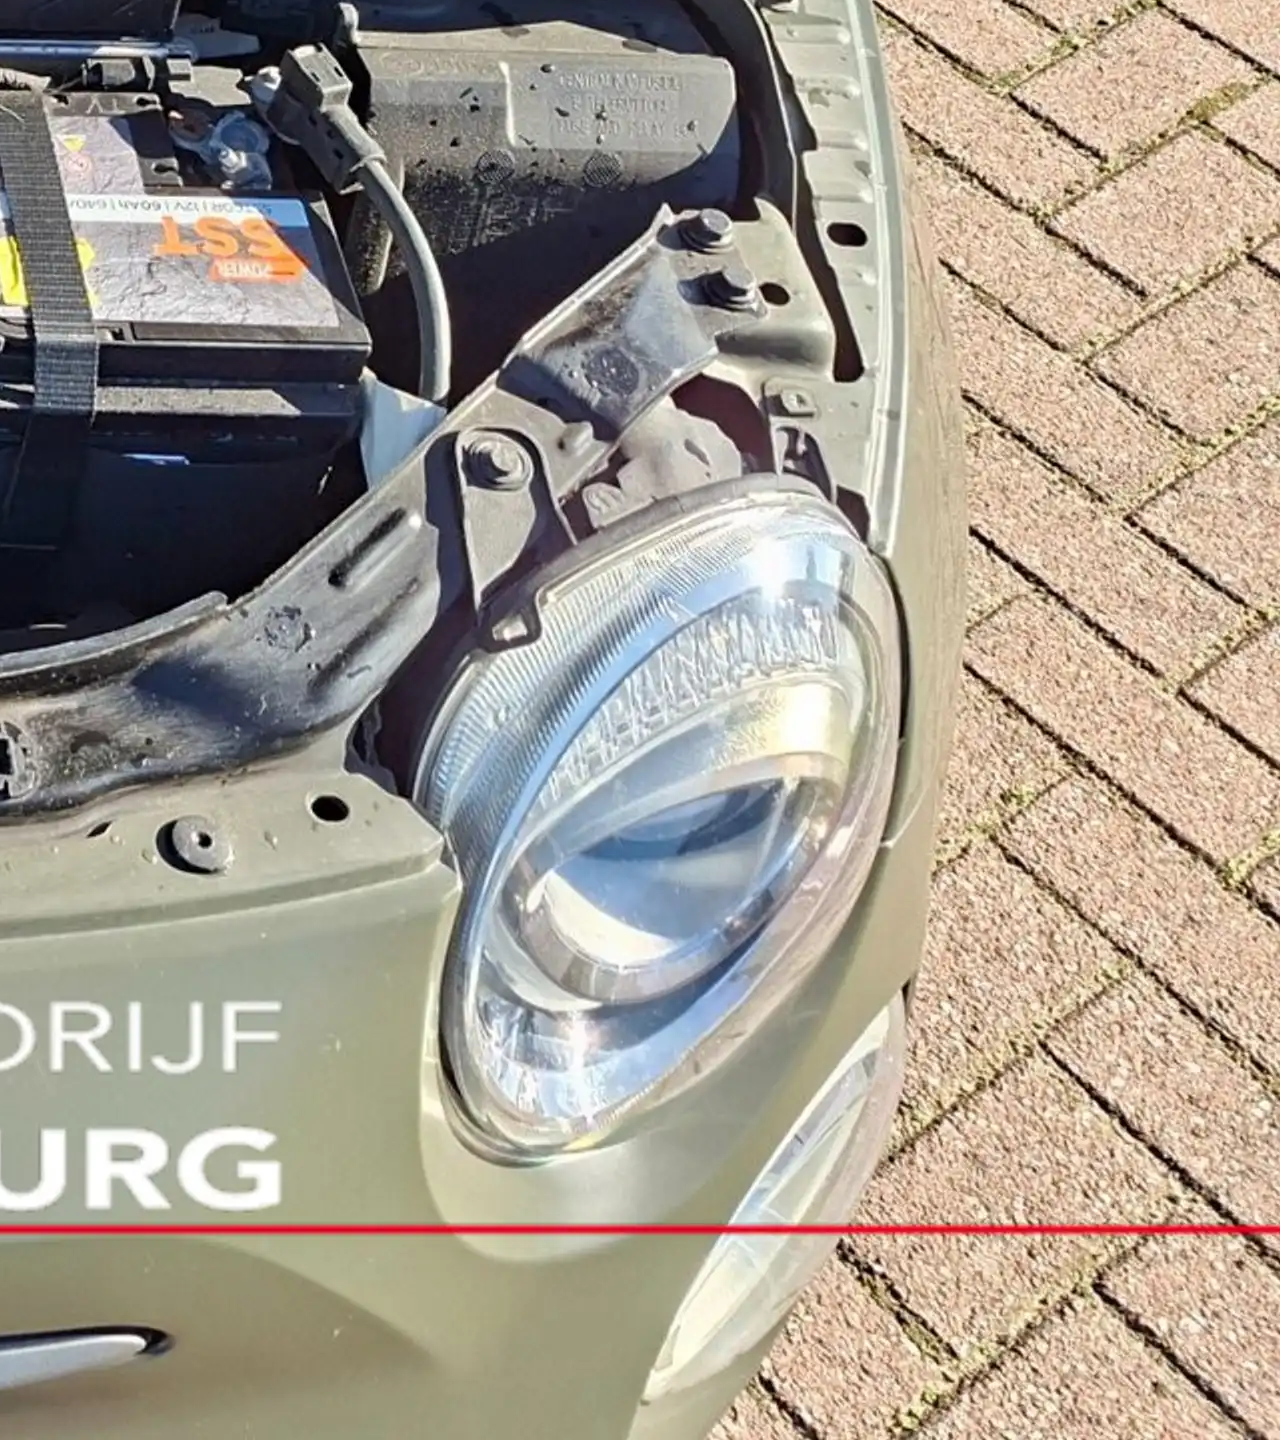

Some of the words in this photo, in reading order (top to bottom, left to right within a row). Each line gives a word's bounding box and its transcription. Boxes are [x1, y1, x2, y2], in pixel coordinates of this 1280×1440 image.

[118, 199, 162, 211] 60Ah
[153, 216, 281, 258] SST
[215, 260, 273, 278] POWER
